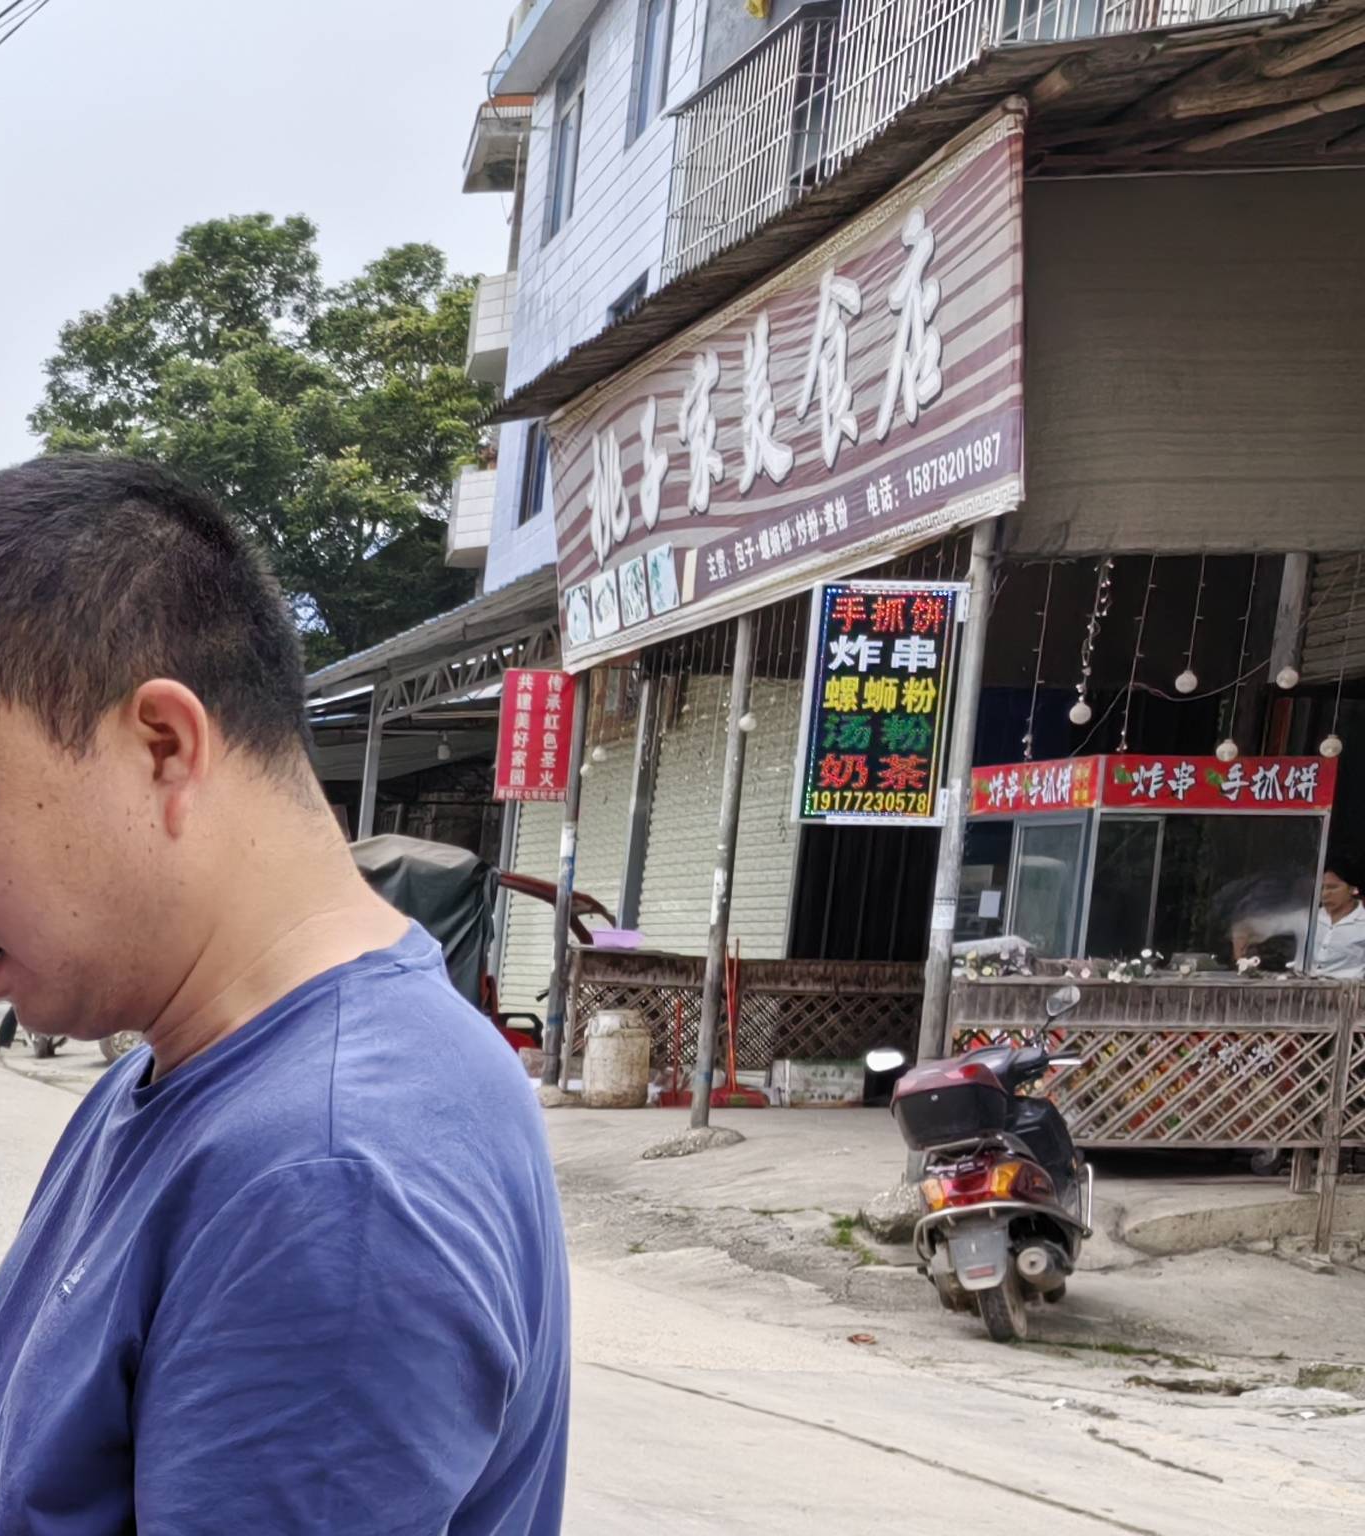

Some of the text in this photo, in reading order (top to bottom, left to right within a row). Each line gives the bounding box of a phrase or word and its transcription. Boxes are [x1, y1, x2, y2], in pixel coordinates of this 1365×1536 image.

[832, 596, 945, 633] 手抓饼
[828, 634, 937, 673] 炸串
[822, 675, 937, 714] 螺蛳粉
[822, 714, 931, 751] 汤粉
[818, 753, 928, 791] 奶茶
[1131, 762, 1196, 803] 炸串
[1220, 761, 1320, 804] 手抓饼
[811, 790, 928, 813] 19177230578
